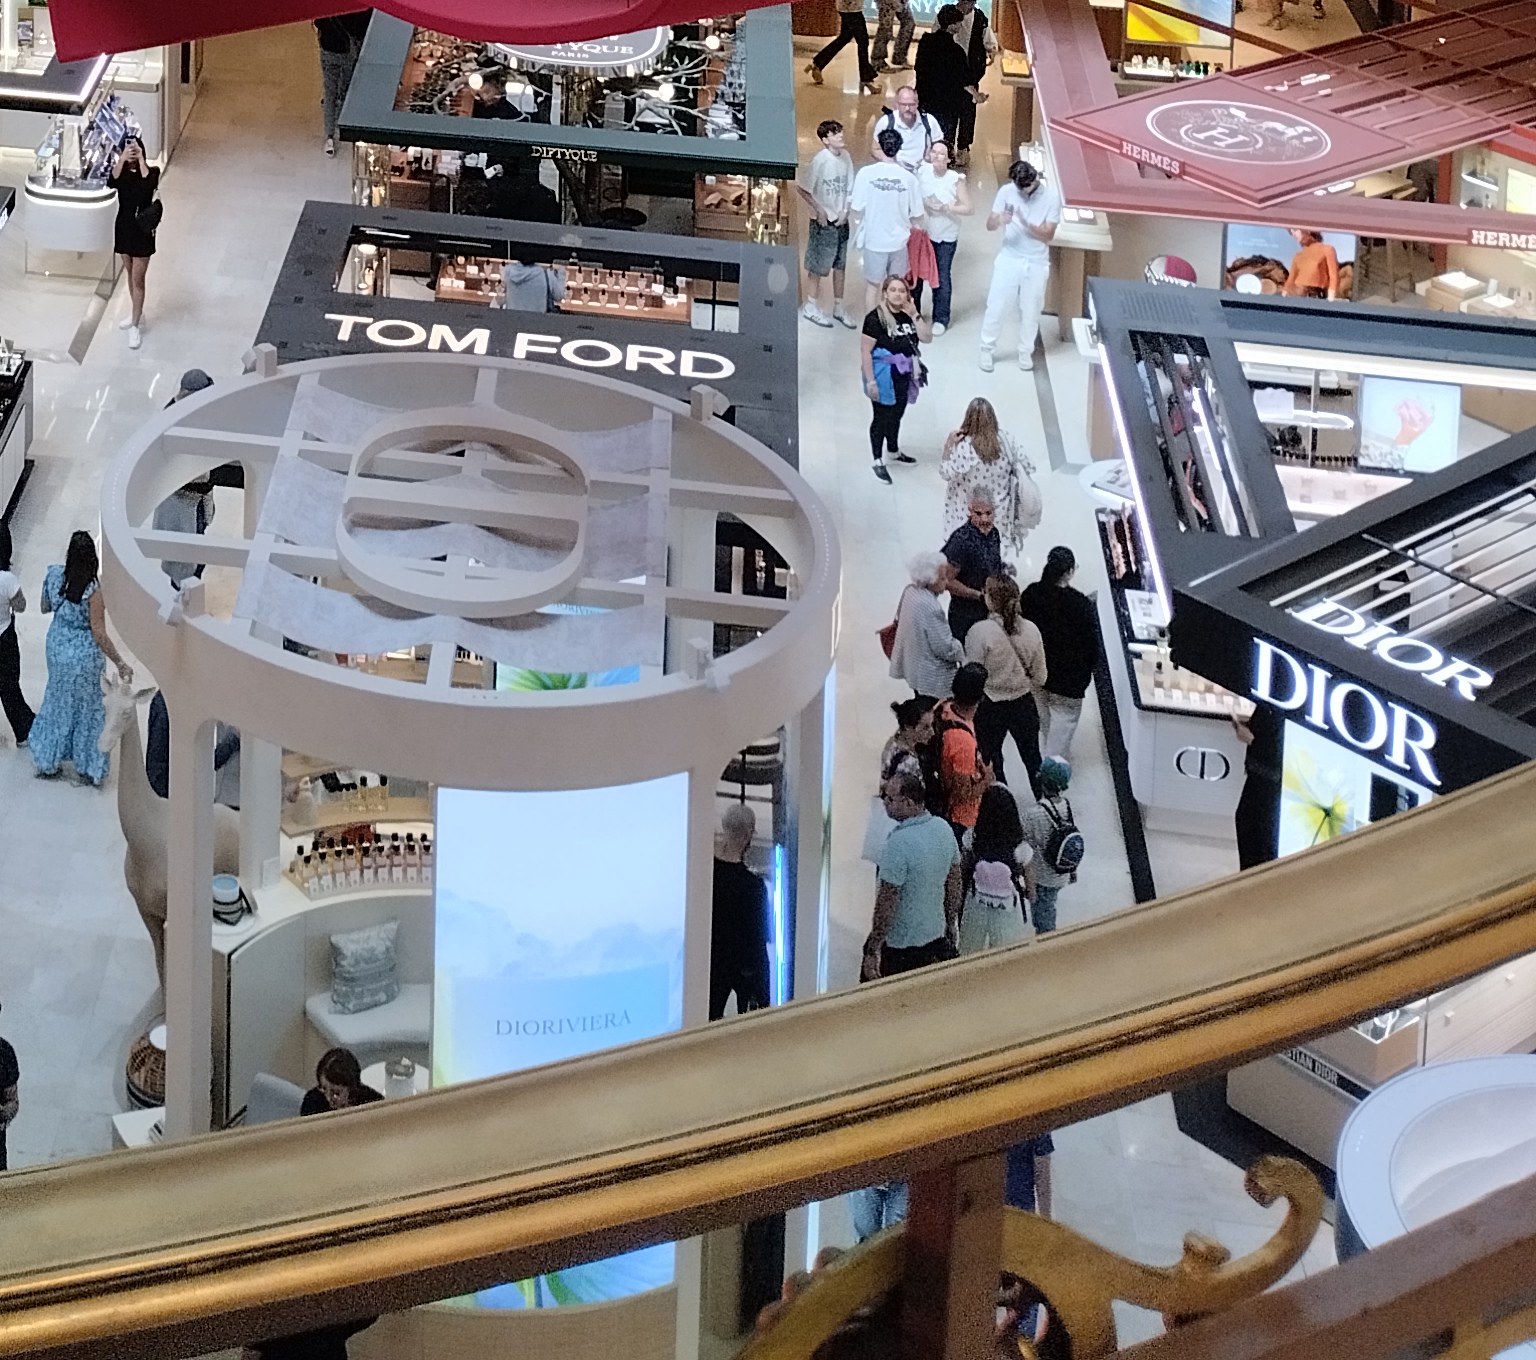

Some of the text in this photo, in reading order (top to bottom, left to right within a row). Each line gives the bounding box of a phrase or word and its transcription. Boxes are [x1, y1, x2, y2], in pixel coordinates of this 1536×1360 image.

[551, 50, 589, 59] PARIS
[530, 146, 598, 162] DIPTYQUE
[324, 313, 736, 379] TOM FORD
[1284, 598, 1494, 701] DIOR
[1250, 637, 1442, 786] DIOR
[496, 1009, 632, 1036] DIORIVIERA
